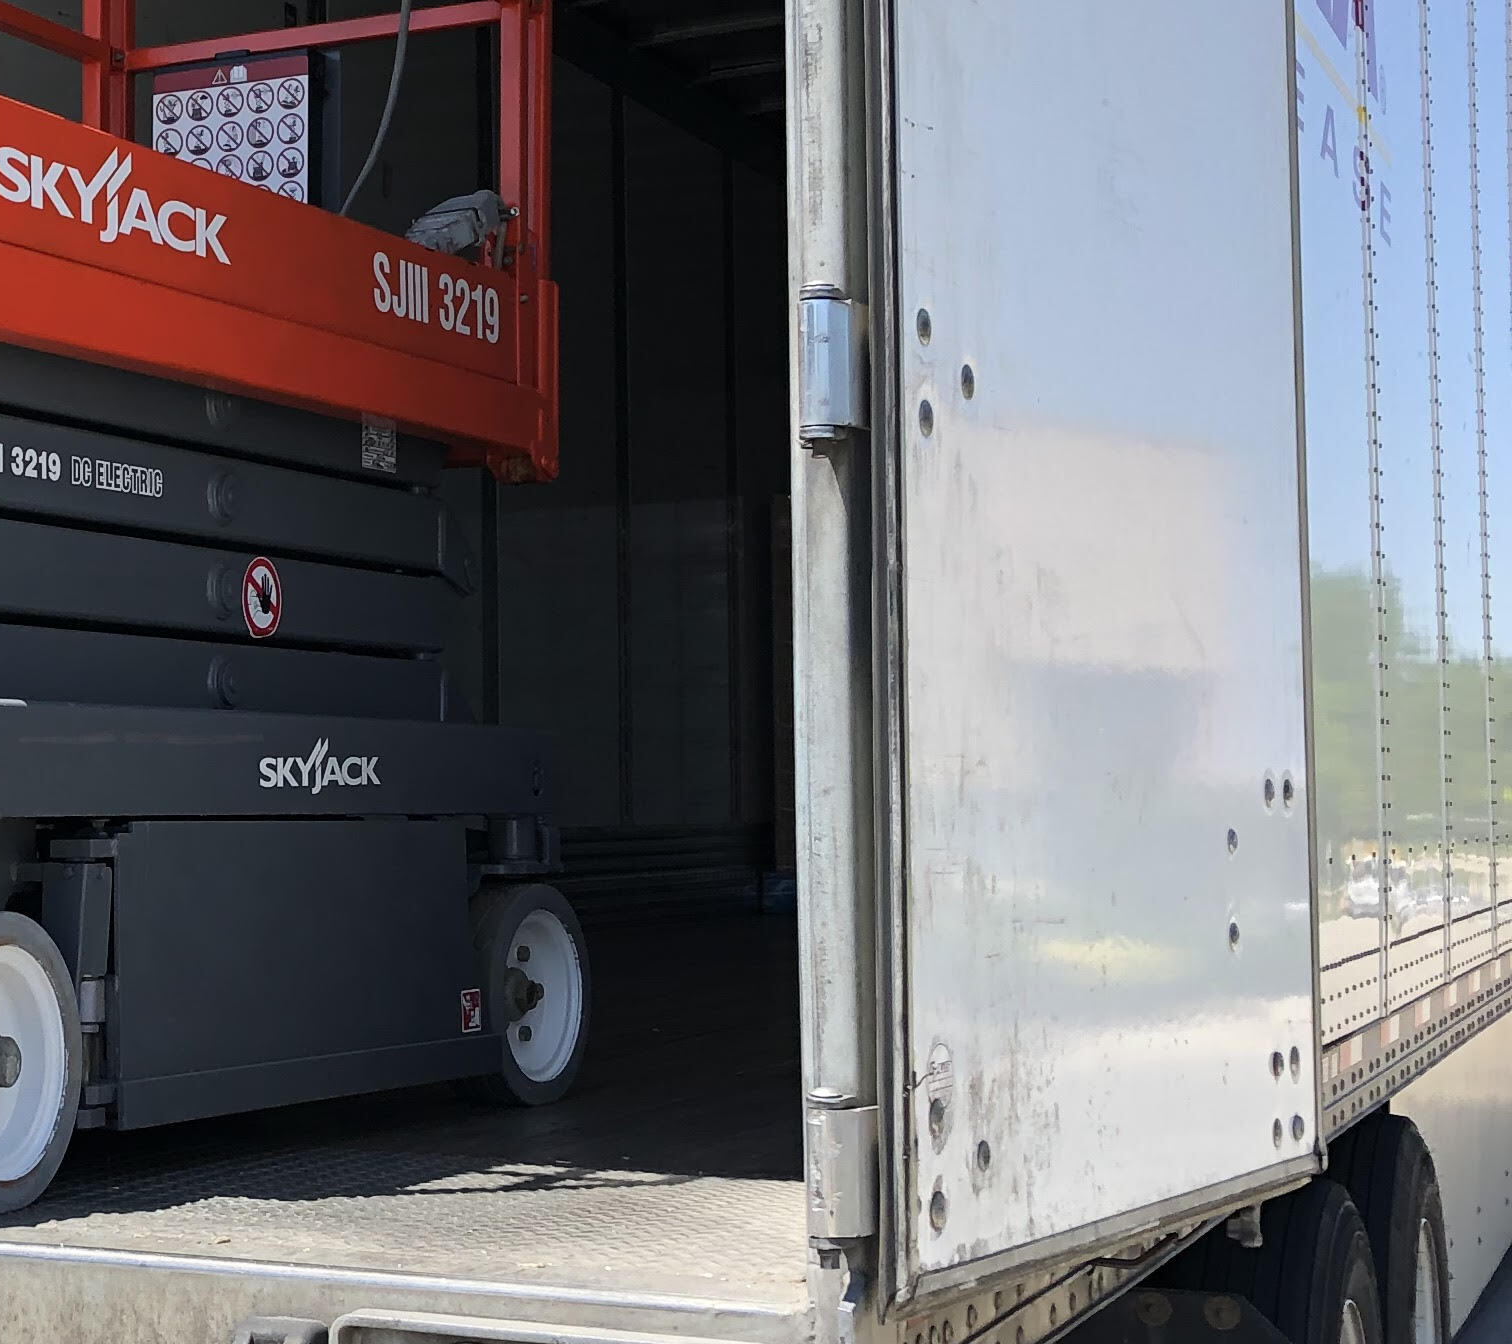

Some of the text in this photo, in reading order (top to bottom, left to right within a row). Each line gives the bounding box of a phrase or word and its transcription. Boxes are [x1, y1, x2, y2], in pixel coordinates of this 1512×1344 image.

[372, 251, 501, 344] SJIII 3219
[10, 445, 62, 482] 3219
[70, 456, 92, 487] DC
[95, 459, 164, 498] ELECTRIC
[258, 736, 381, 795] SKYJACK
